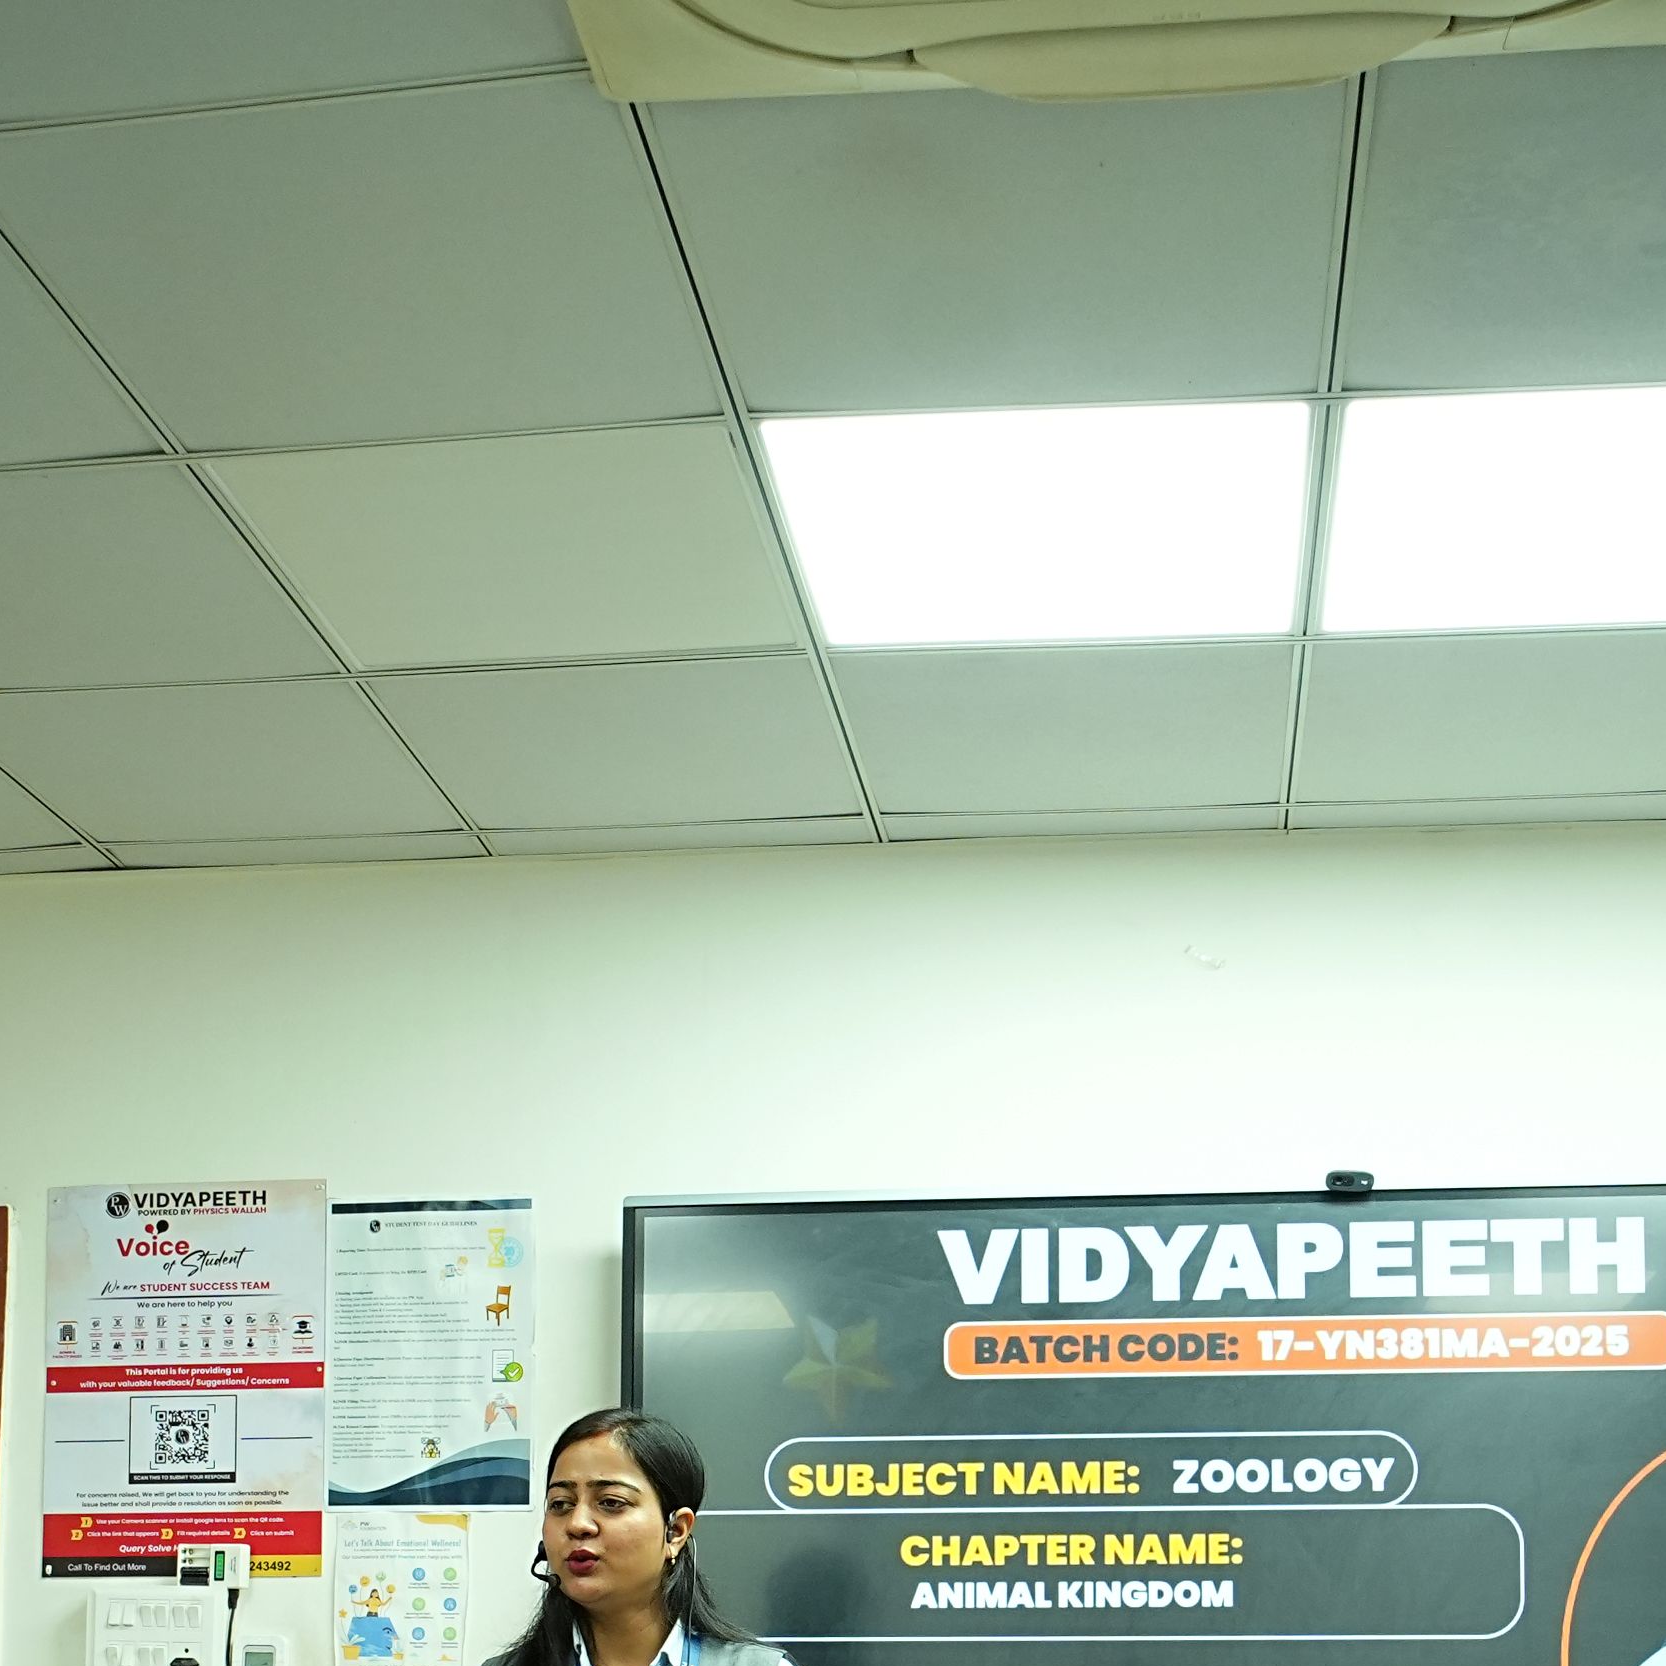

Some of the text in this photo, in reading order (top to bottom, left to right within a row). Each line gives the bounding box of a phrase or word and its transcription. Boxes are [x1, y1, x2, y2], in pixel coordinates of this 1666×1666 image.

[133, 1190, 267, 1208] VIDYAPEETH
[116, 1235, 189, 1257] Voice
[163, 1247, 254, 1277] of Student
[937, 1215, 1647, 1306] VIDYAPEETH
[101, 1280, 121, 1296] We
[140, 1283, 187, 1292] STUDENT
[190, 1282, 238, 1291] SUCCESS
[240, 1282, 270, 1290] TEAM
[137, 1301, 151, 1309] We
[196, 1300, 213, 1309] help
[215, 1301, 233, 1309] you
[974, 1326, 1631, 1365] BATCH CODE: 17-YN381MA-2025
[125, 1368, 142, 1376] This
[169, 1367, 175, 1375] is
[189, 1367, 230, 1376] providing
[80, 1376, 290, 1389] with your valuable feedback/ Suggestions/ Concerns
[788, 1457, 1395, 1498] SUBJECT NAME: ZOOLOGY
[165, 1491, 176, 1499] get
[119, 1544, 172, 1554] Query Solve
[900, 1532, 1243, 1566] CHAPTER NAME:
[68, 1563, 146, 1572] Call To Find Out More
[910, 1579, 1234, 1609] ANIMAL KINGDOM
